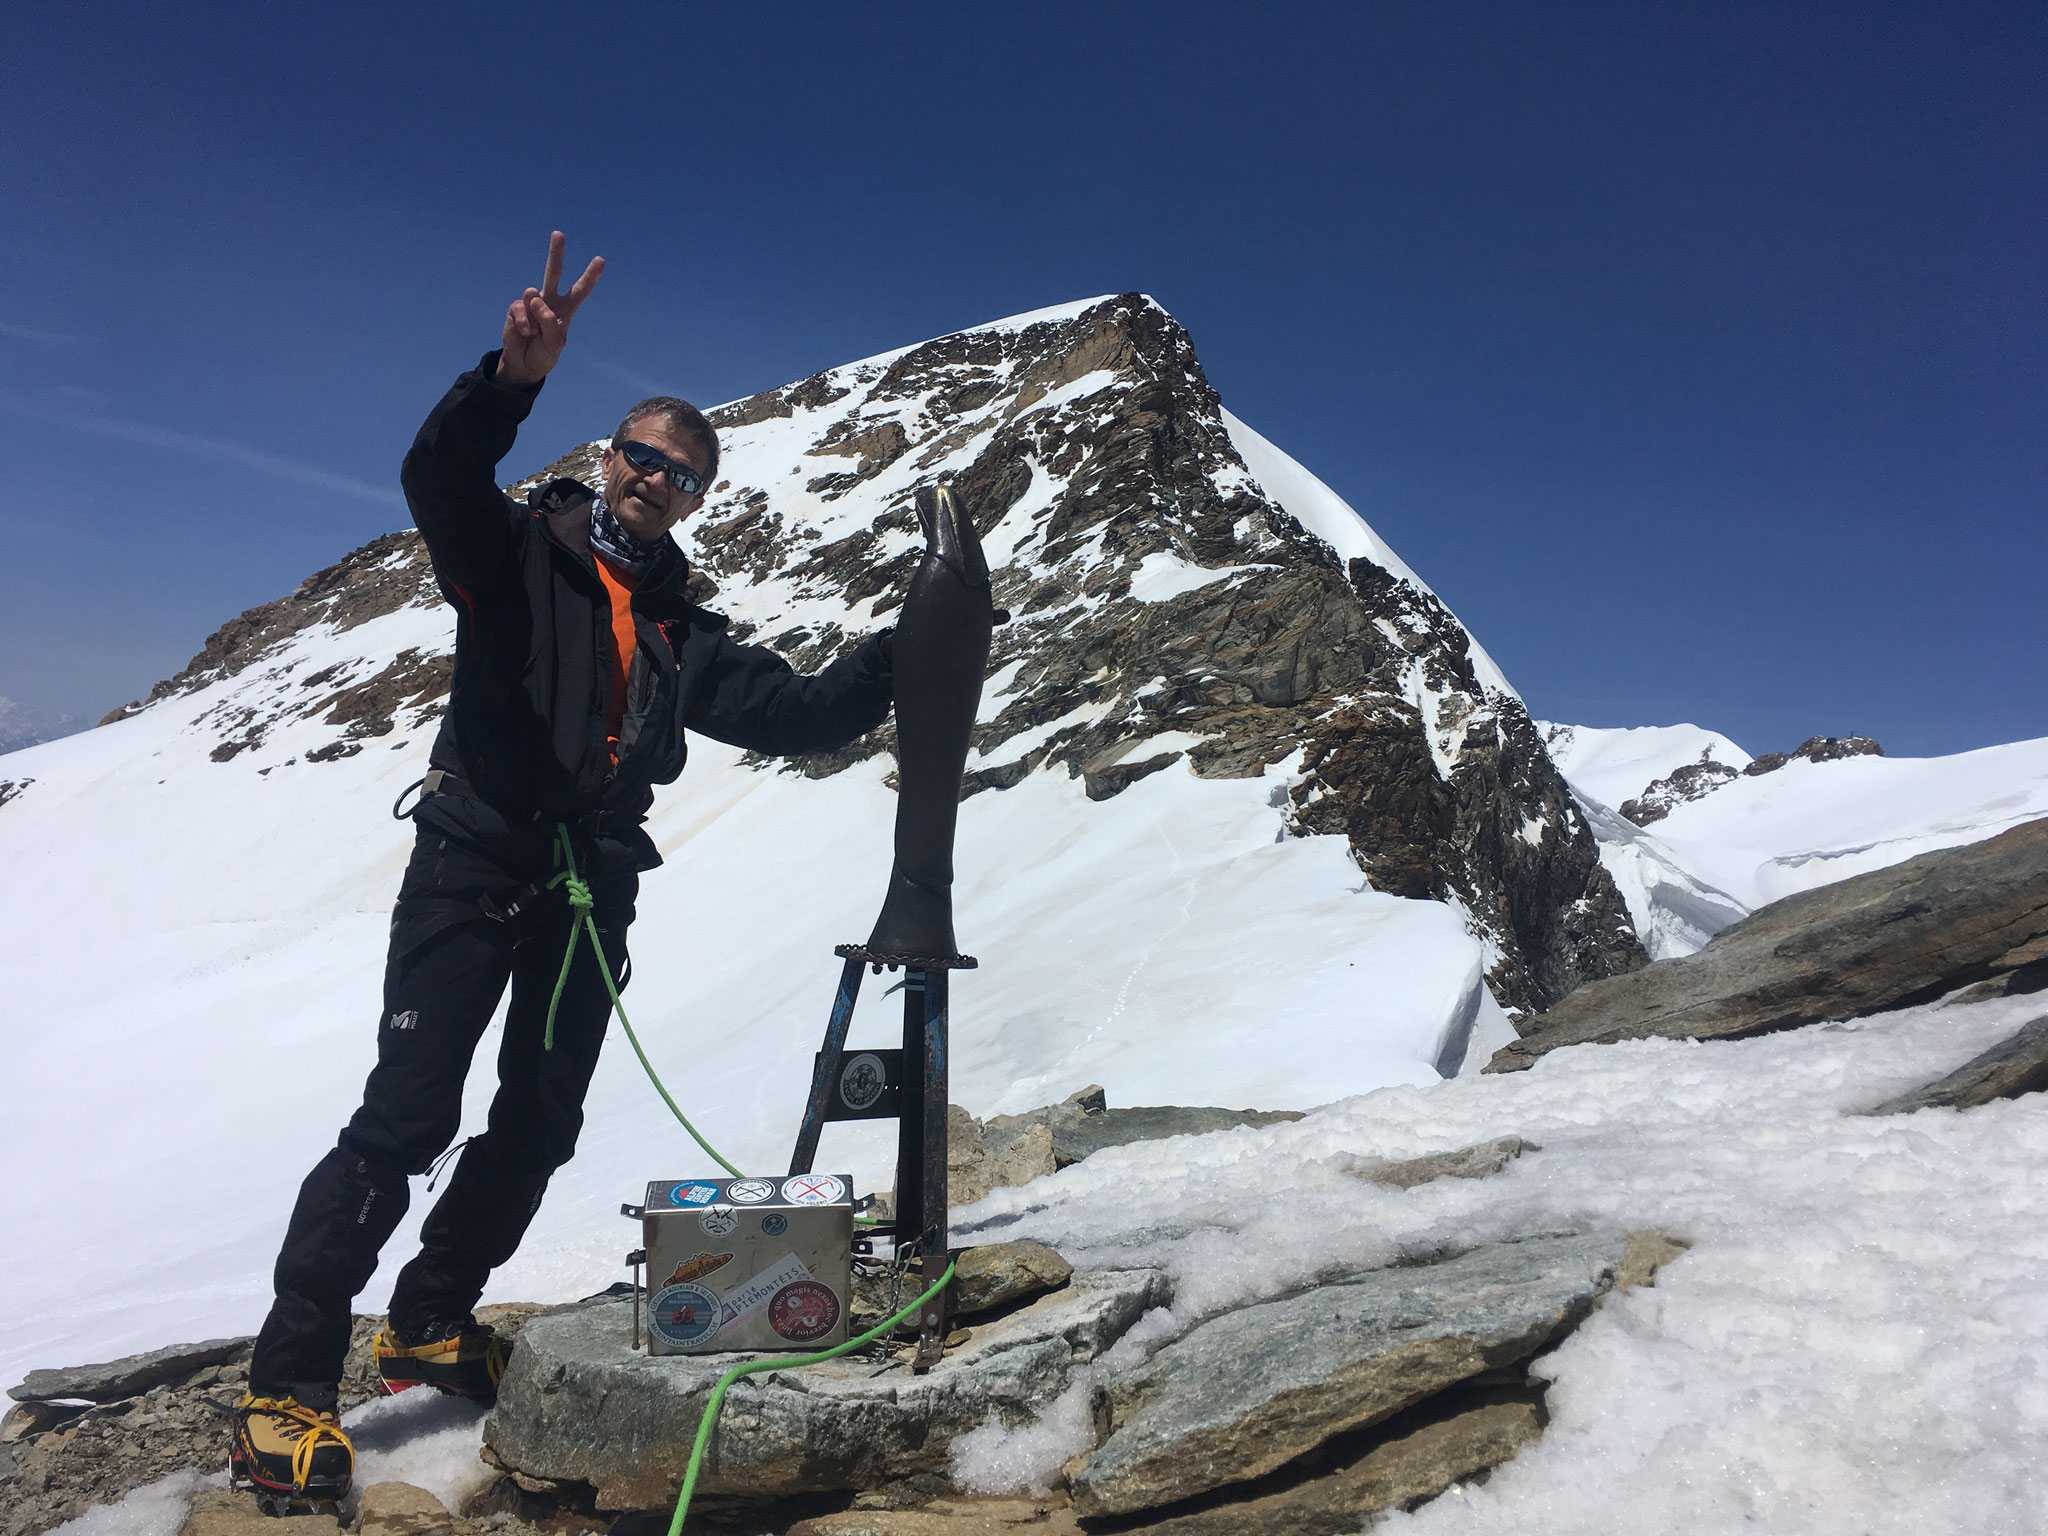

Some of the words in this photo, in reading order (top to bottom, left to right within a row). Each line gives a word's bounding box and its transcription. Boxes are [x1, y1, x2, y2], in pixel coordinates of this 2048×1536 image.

[357, 1190, 376, 1224] GORE-TEX
[667, 1284, 695, 1293] MOUNTAIN
[785, 1287, 811, 1297] magis
[774, 1296, 785, 1311] quo
[824, 1307, 835, 1323] hoc
[796, 1322, 829, 1336] brevior
